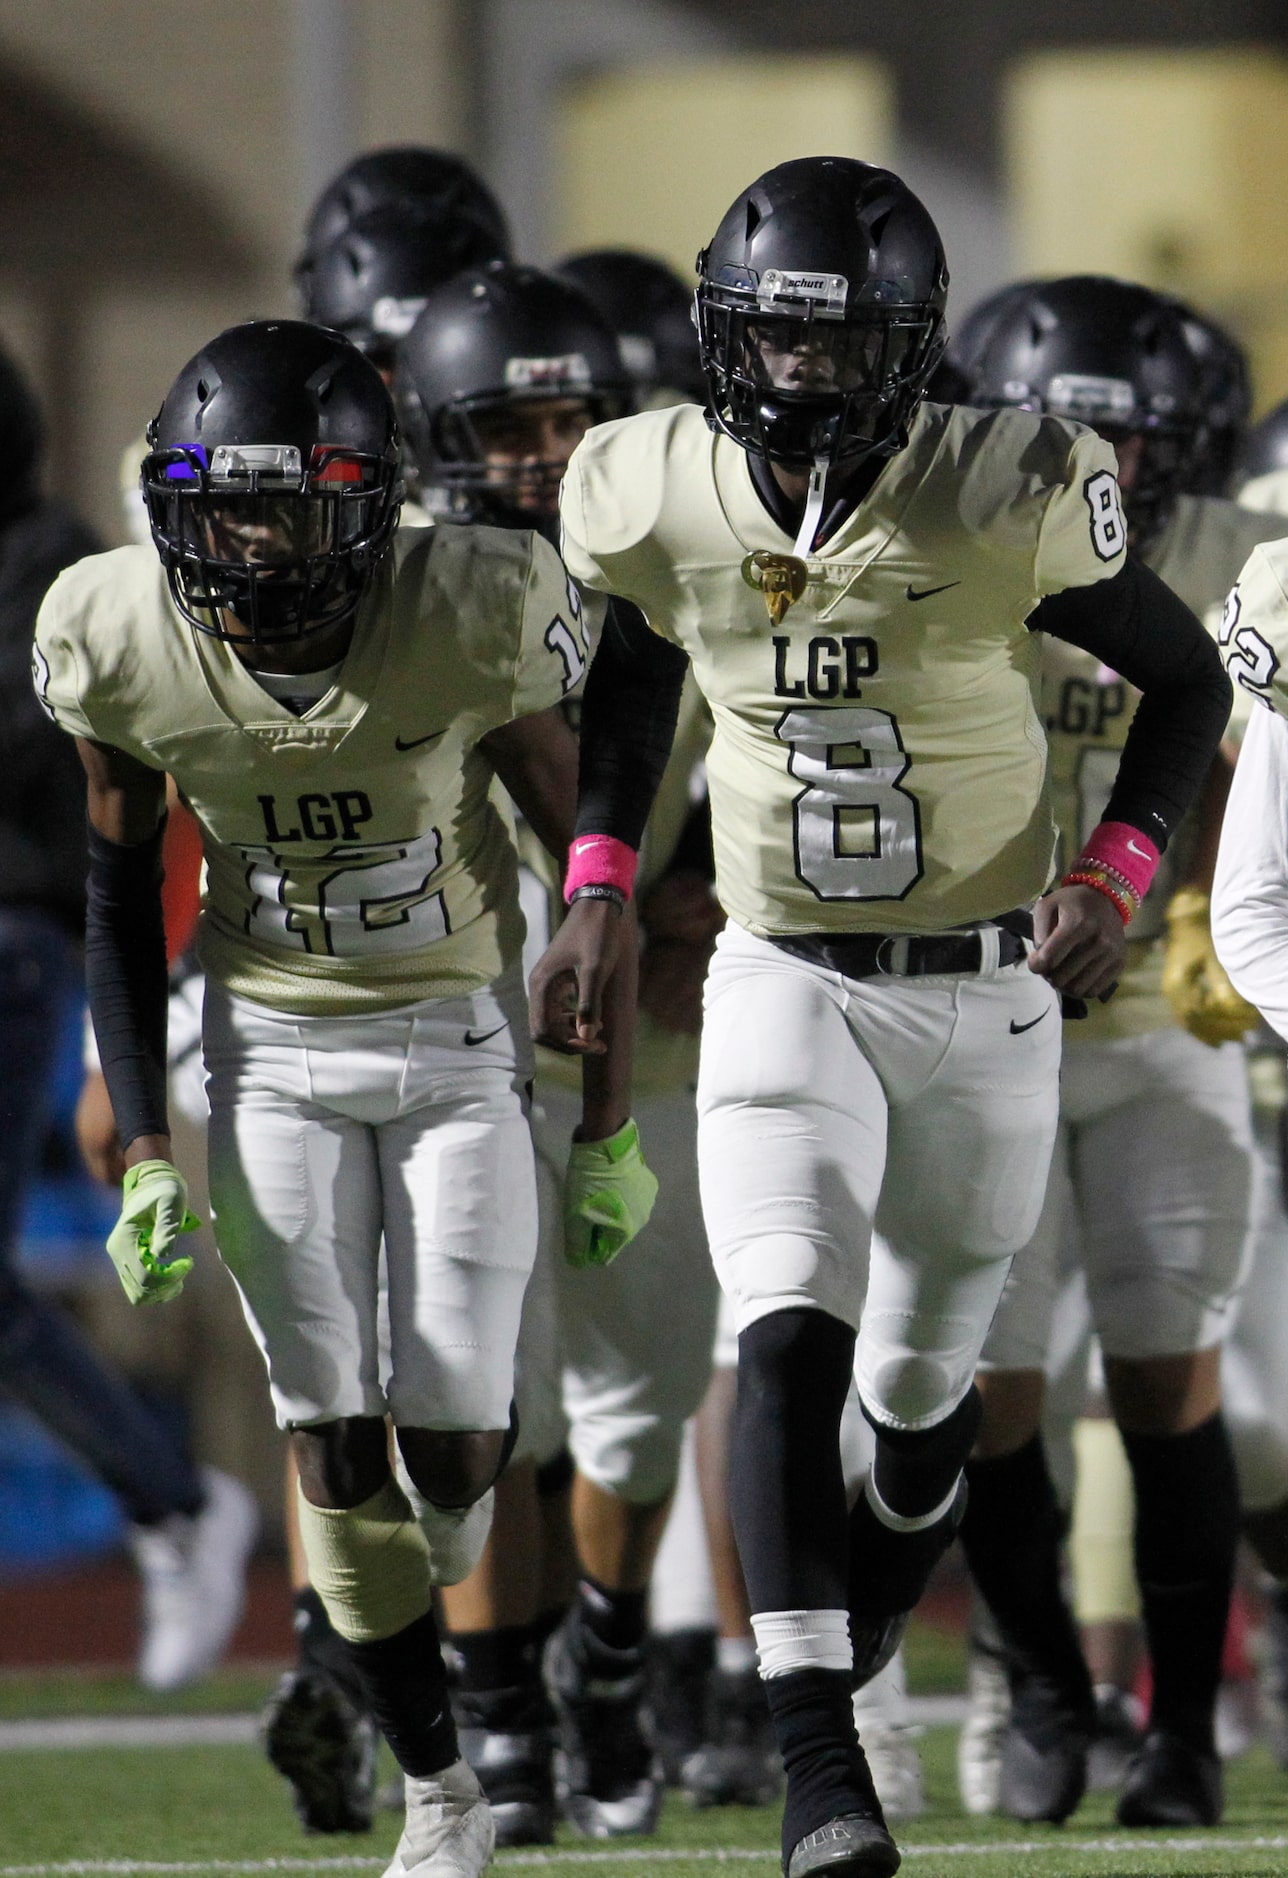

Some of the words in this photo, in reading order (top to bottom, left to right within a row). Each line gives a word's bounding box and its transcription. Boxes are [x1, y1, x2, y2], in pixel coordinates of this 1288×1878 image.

[788, 278, 825, 289] schutt
[1082, 469, 1125, 563] 8
[772, 635, 879, 699] LGP
[1046, 675, 1127, 738] GP
[257, 790, 373, 842] LGP
[773, 705, 925, 902] 8
[228, 825, 453, 957] 12
